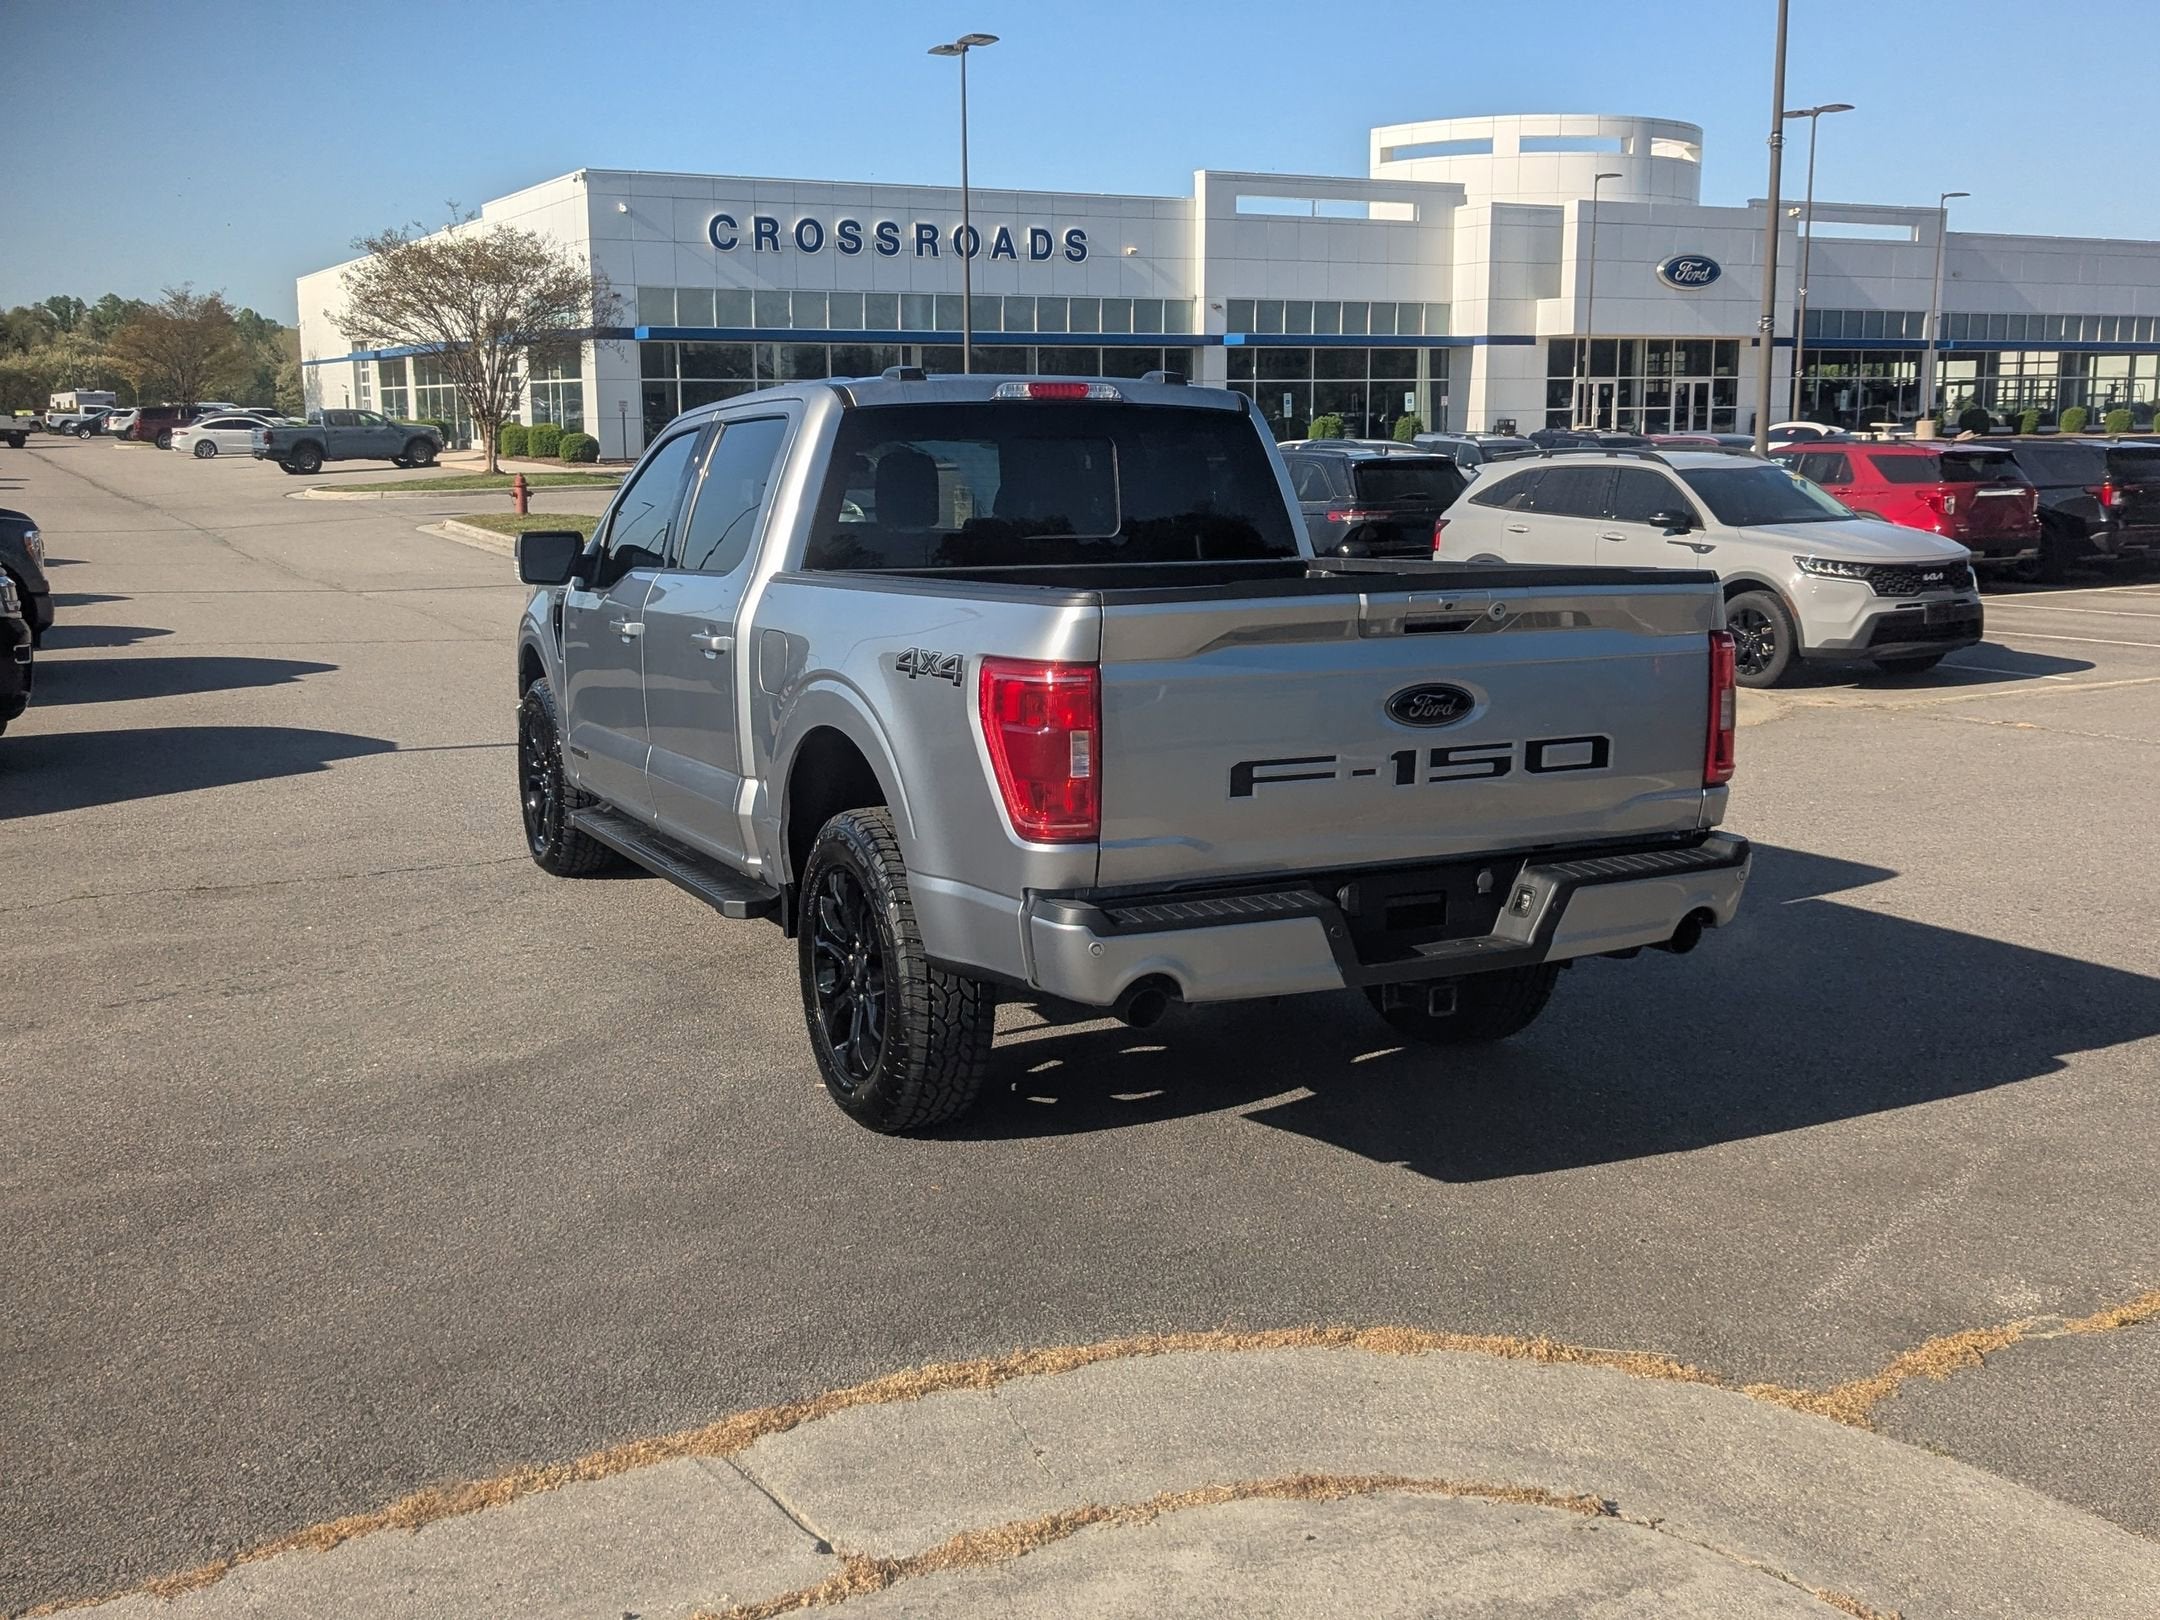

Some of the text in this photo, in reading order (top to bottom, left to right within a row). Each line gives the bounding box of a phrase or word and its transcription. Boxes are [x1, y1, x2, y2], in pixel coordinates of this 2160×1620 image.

[708, 213, 1088, 263] CROSSROADS
[1675, 261, 1711, 281] Ford
[1409, 694, 1458, 717] Ford
[1229, 735, 1610, 798] F-150
